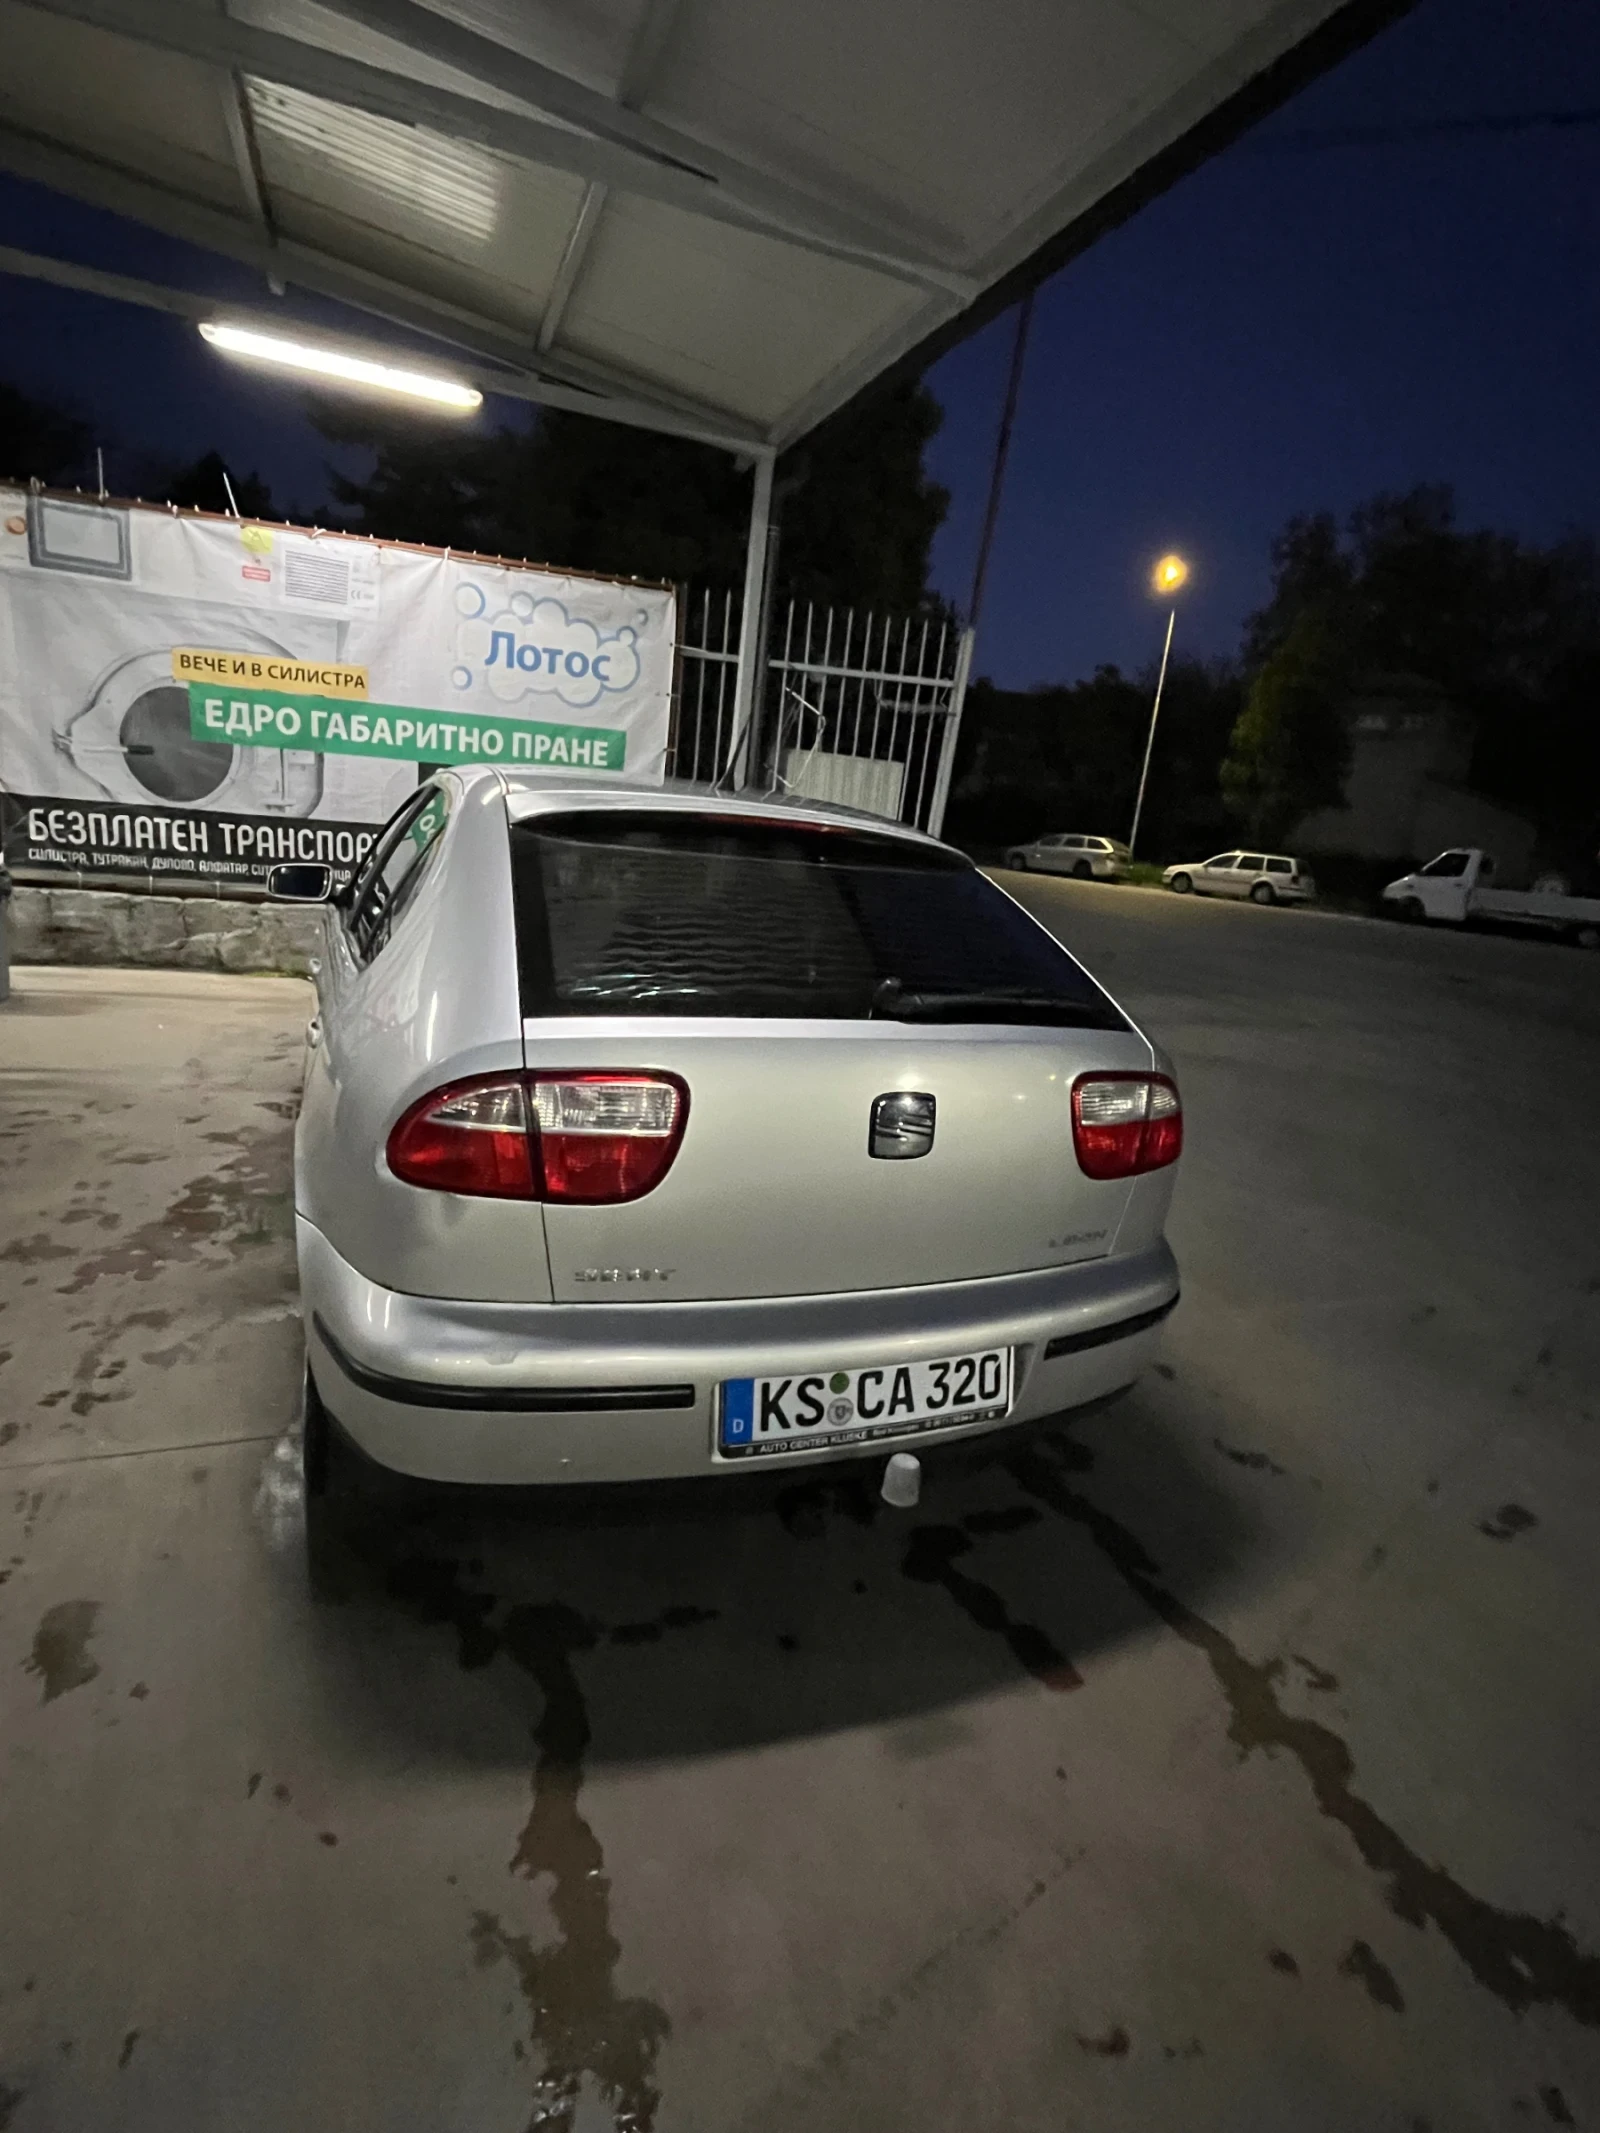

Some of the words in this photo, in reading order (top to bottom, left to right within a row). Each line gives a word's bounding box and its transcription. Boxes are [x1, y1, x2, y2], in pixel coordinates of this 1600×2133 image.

[180, 654, 228, 674] ВЕЧЕ
[232, 661, 246, 676] И
[251, 663, 263, 677] В
[267, 665, 366, 689] СИЛИСТРА
[484, 630, 611, 682] Лотос
[205, 698, 301, 738] ЕДРО
[310, 710, 505, 756] ГАБАРИТНО
[511, 732, 609, 767] ПРАНЕ
[28, 808, 209, 854] БЕЗПЛАТЕН
[218, 822, 379, 864] ТРАНСПОР
[760, 1377, 825, 1433] KS
[857, 1366, 915, 1420] CA
[926, 1353, 1002, 1410] 320
[732, 1418, 744, 1434] D
[759, 1438, 789, 1454] AUTO
[789, 1434, 829, 1450] CENTER
